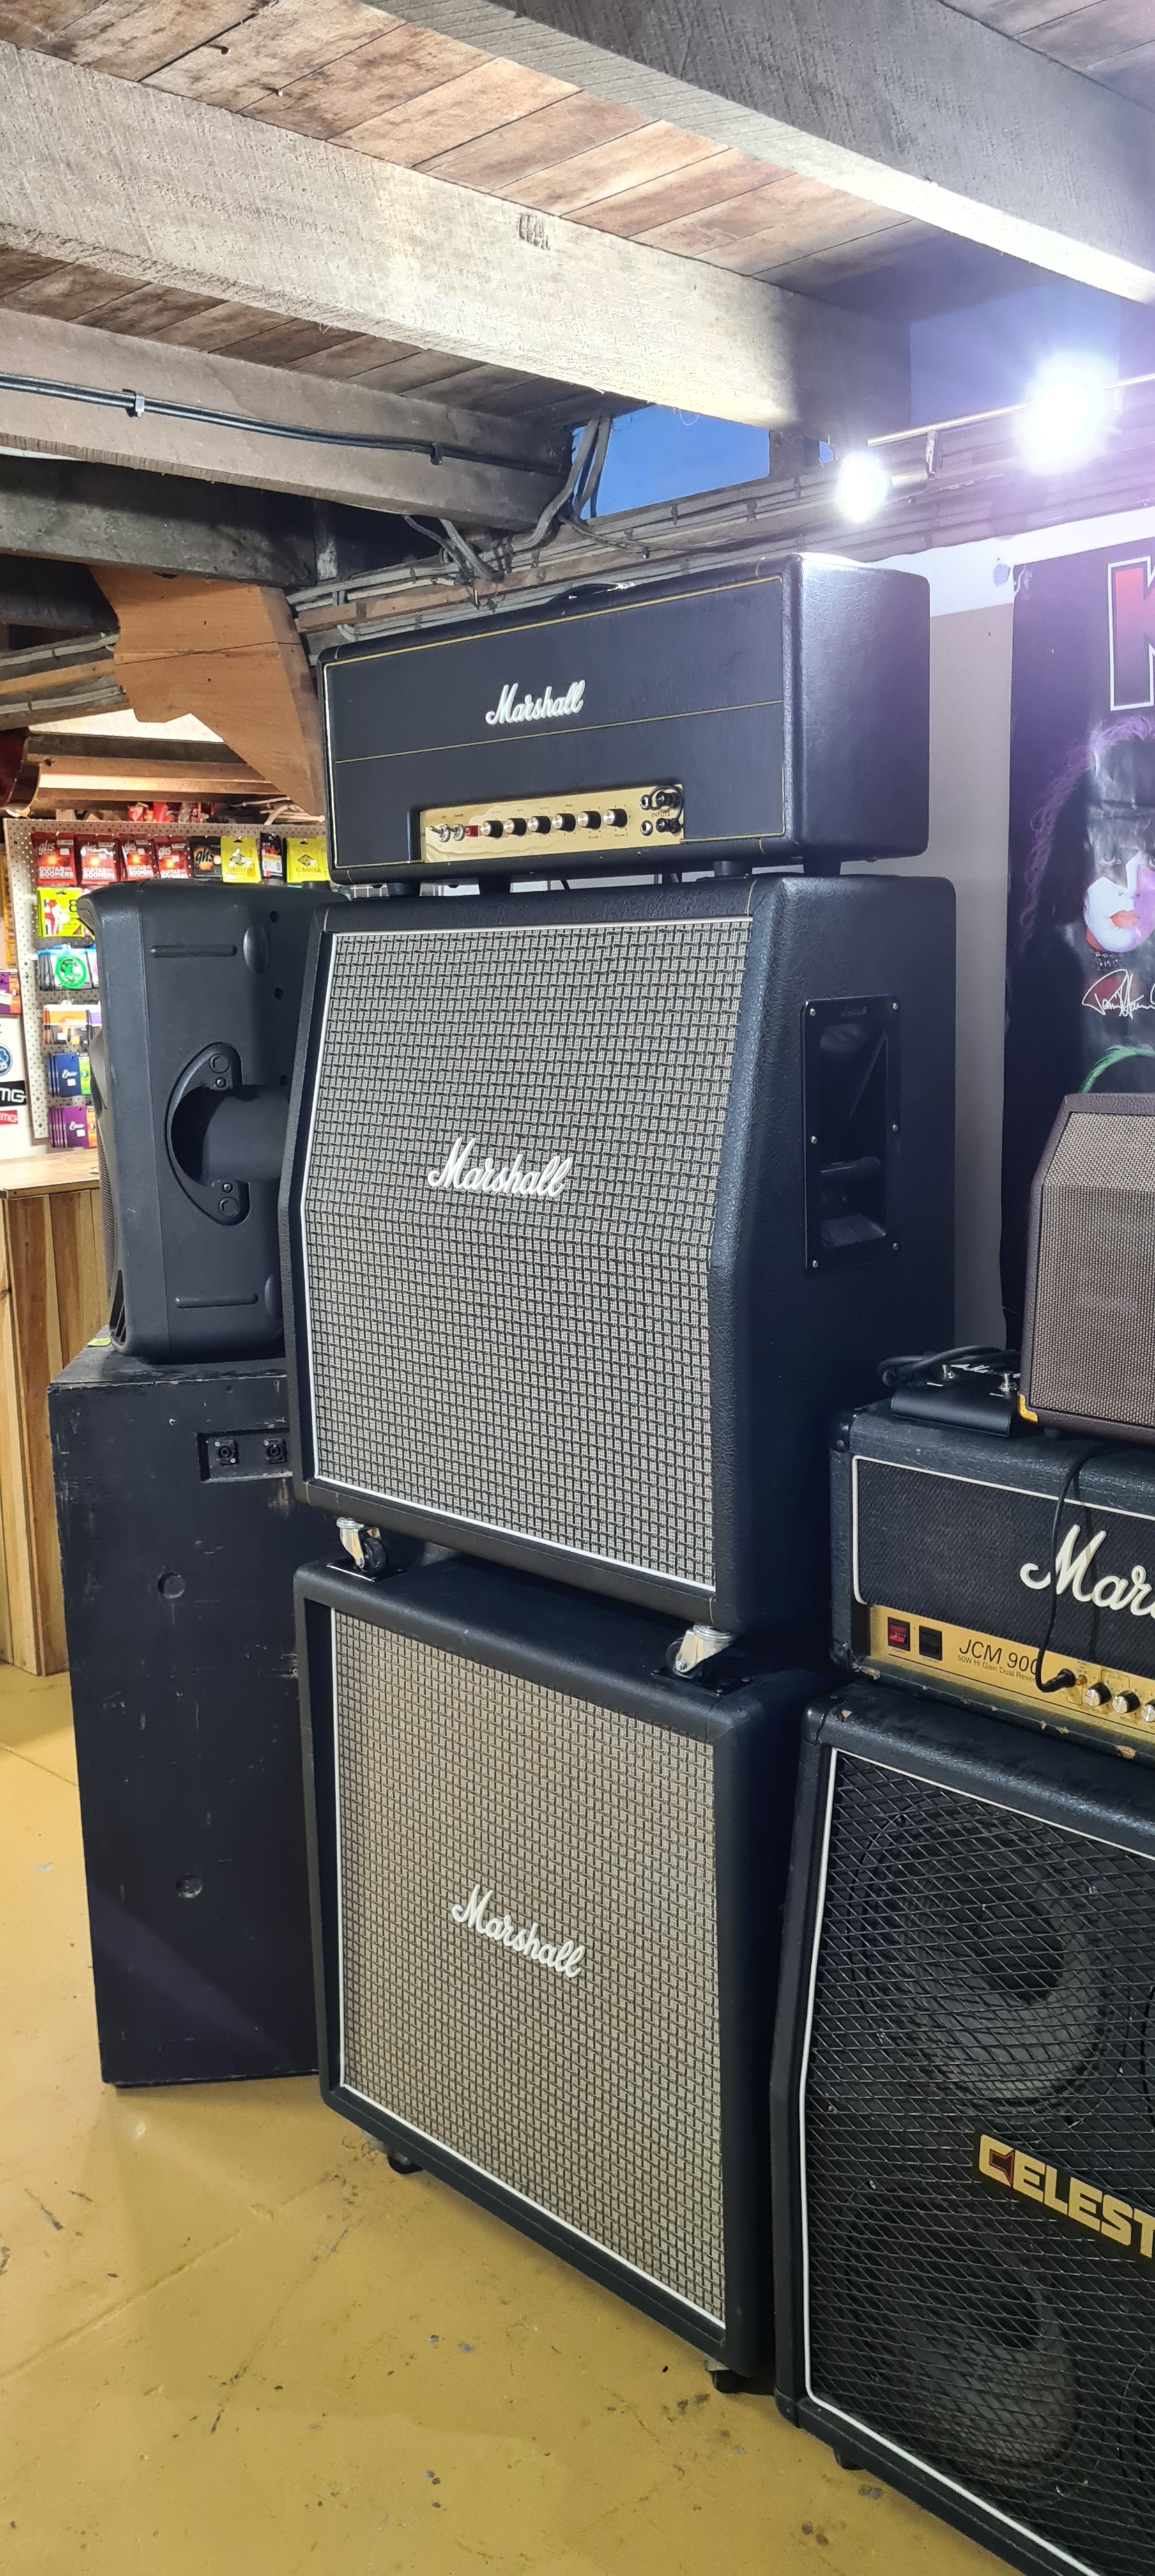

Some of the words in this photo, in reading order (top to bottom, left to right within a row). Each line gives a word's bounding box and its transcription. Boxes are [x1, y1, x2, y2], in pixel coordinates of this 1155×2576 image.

[486, 679, 586, 725] Marshall
[195, 847, 214, 864] ghs
[427, 1137, 573, 1197] Marshall
[958, 1655, 972, 1664] 50W
[983, 1662, 998, 1672] Gain
[999, 1667, 1014, 1677] Dual
[1016, 1671, 1036, 1683] Rever
[959, 1639, 1002, 1664] JCM
[452, 1884, 585, 1978] Marshall
[979, 2134, 1155, 2258] CELEST
